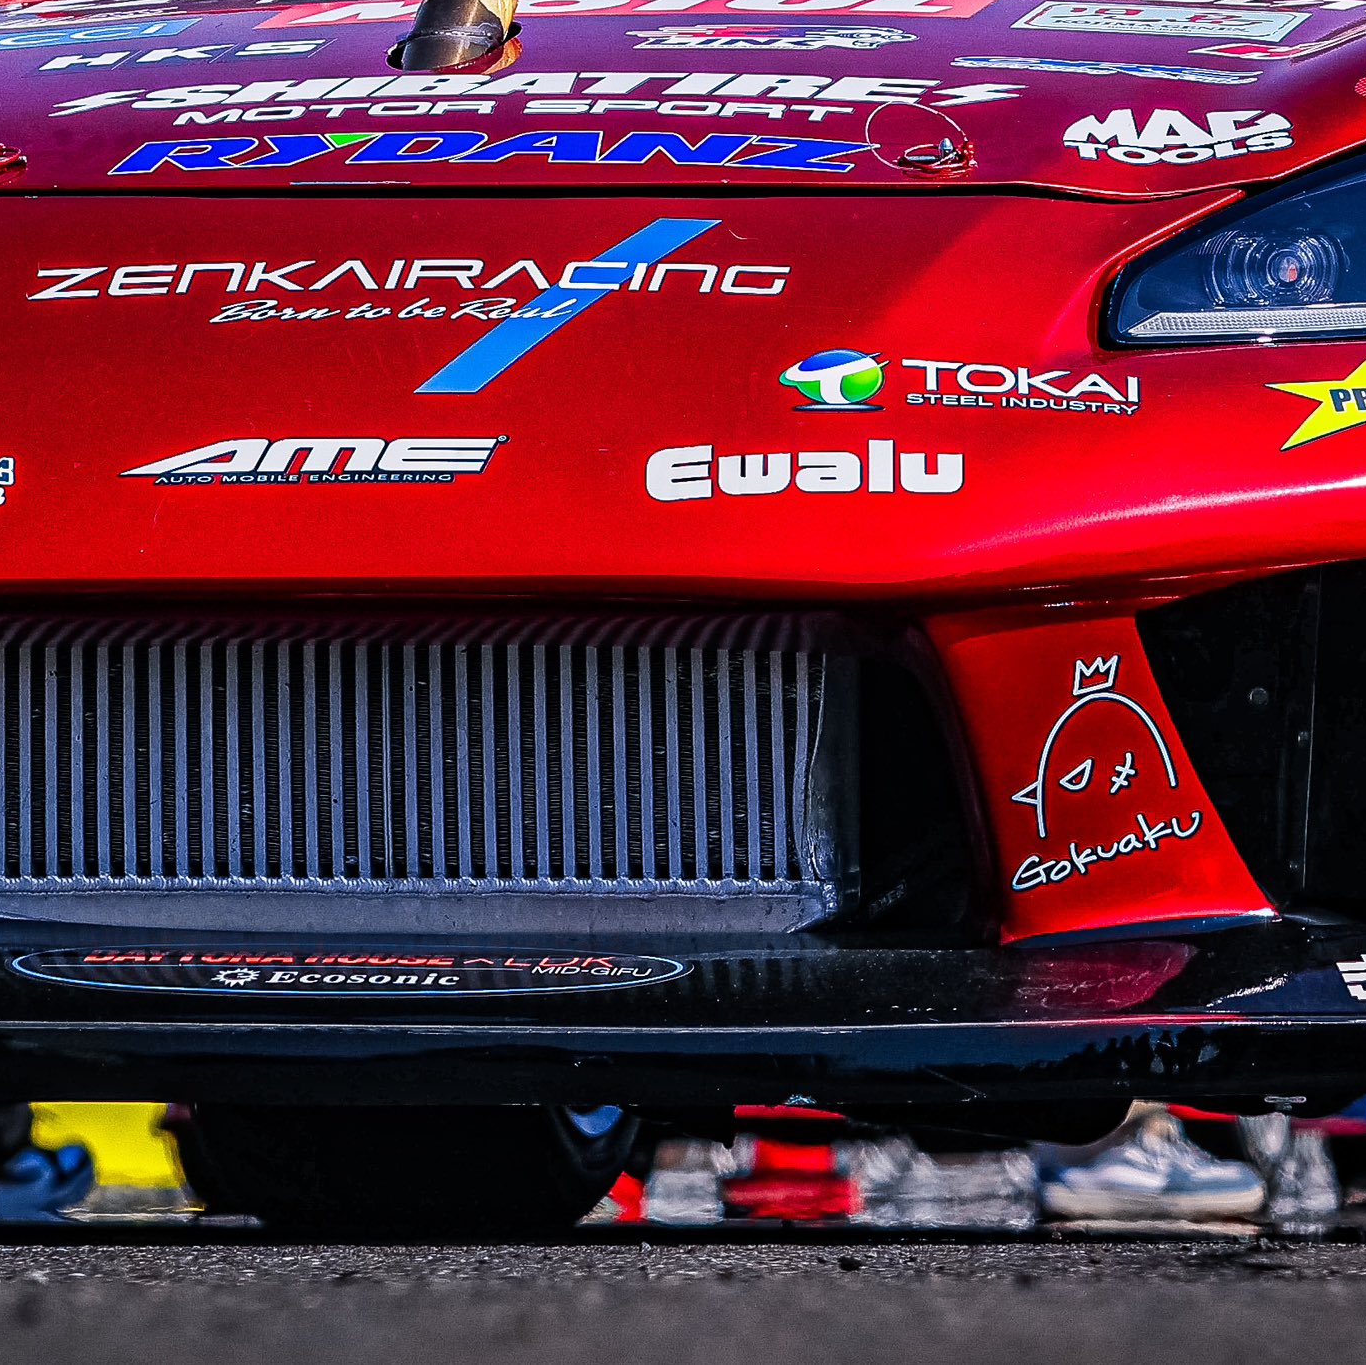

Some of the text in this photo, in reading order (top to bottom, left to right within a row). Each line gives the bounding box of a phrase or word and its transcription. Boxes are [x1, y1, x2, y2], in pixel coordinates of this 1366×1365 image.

[38, 38, 328, 72] HKS
[132, 70, 943, 108] SHIBATIRE
[172, 98, 855, 126] MOTOR SPORT
[1062, 108, 1294, 150] MAC
[108, 131, 881, 175] RYDANZ
[1070, 129, 1294, 164] TOOLS
[28, 259, 792, 300] ZENKAIRACING
[209, 297, 578, 324] Born to be Real
[902, 358, 1140, 403] TOKAI
[906, 392, 1139, 415] STEEL INDUSTRY
[119, 437, 499, 475] AME
[645, 438, 965, 503] Ewalu
[155, 472, 456, 485] AUTO MOBILE ENGINEERING
[1011, 811, 1200, 891] Gokuaku
[265, 970, 461, 986] Ecosonic
[531, 965, 653, 978] MID-GIFU
